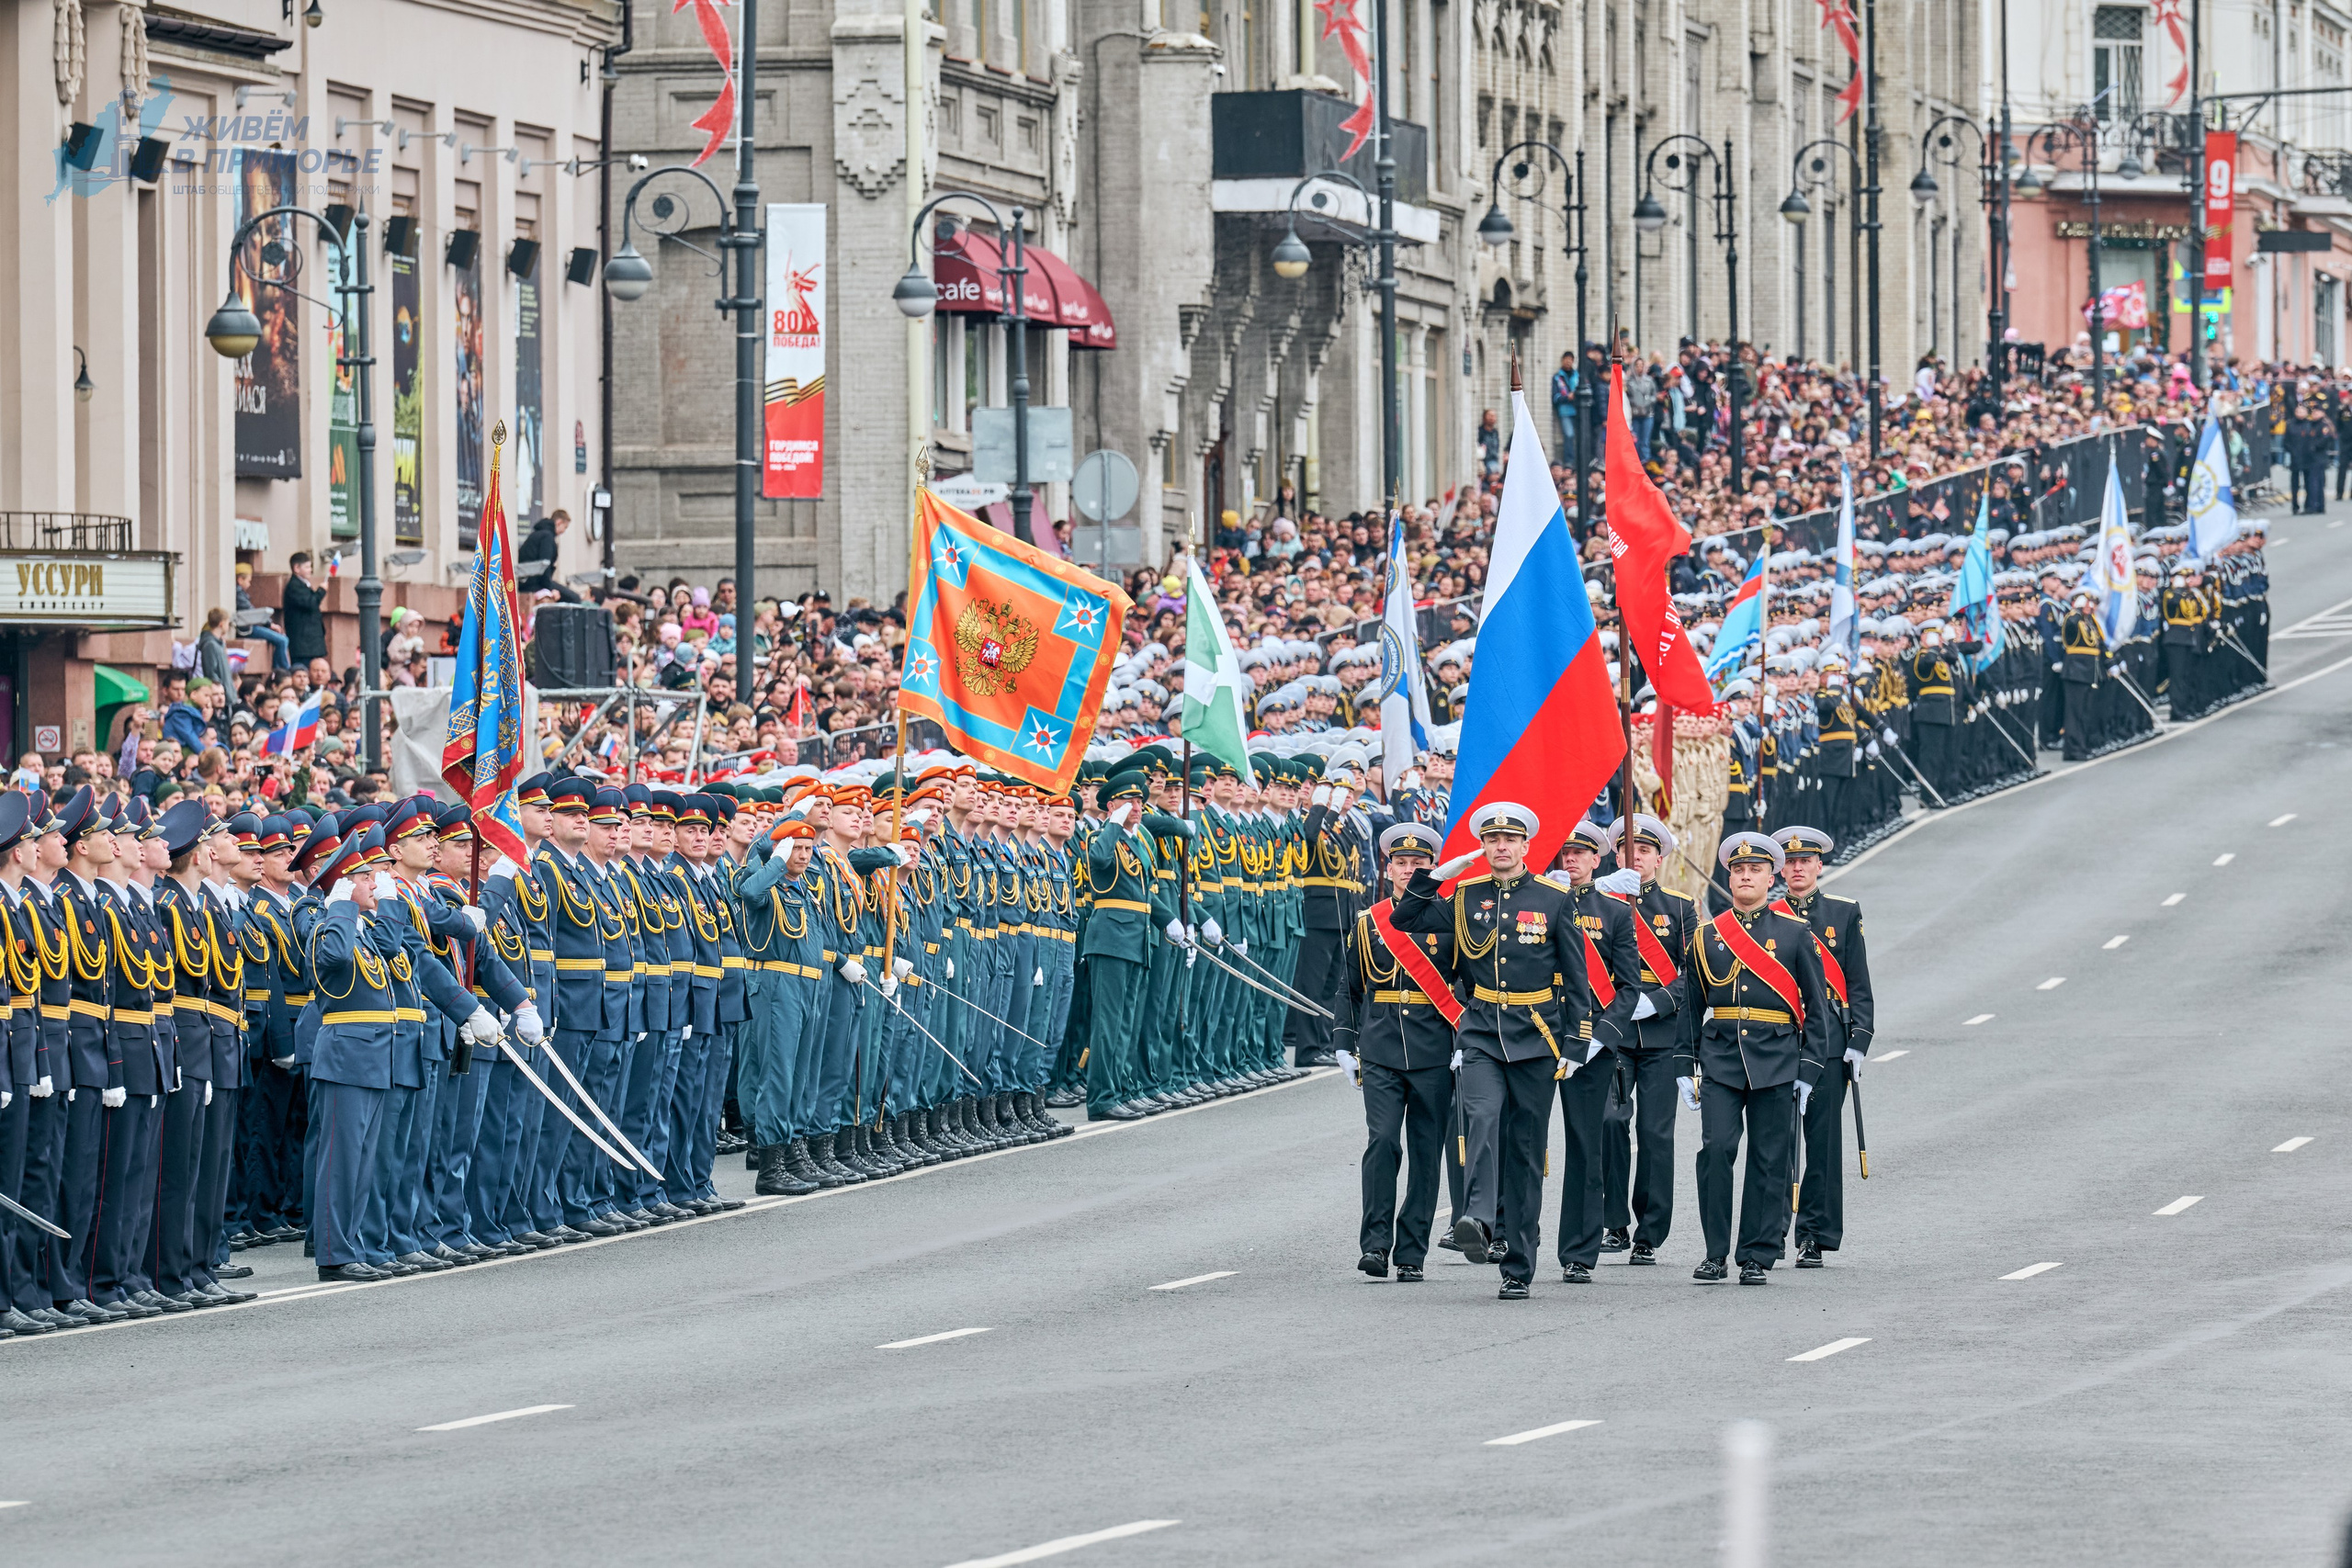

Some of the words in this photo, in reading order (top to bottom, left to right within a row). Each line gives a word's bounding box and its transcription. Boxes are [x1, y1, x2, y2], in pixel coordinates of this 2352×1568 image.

[2210, 159, 2231, 197] 9
[933, 277, 980, 300] cafe
[774, 310, 798, 333] 80
[773, 336, 820, 348] ПОБЕДА!
[17, 563, 104, 596] УССУРИ
[19, 601, 105, 610] КИНОТЕАТР
